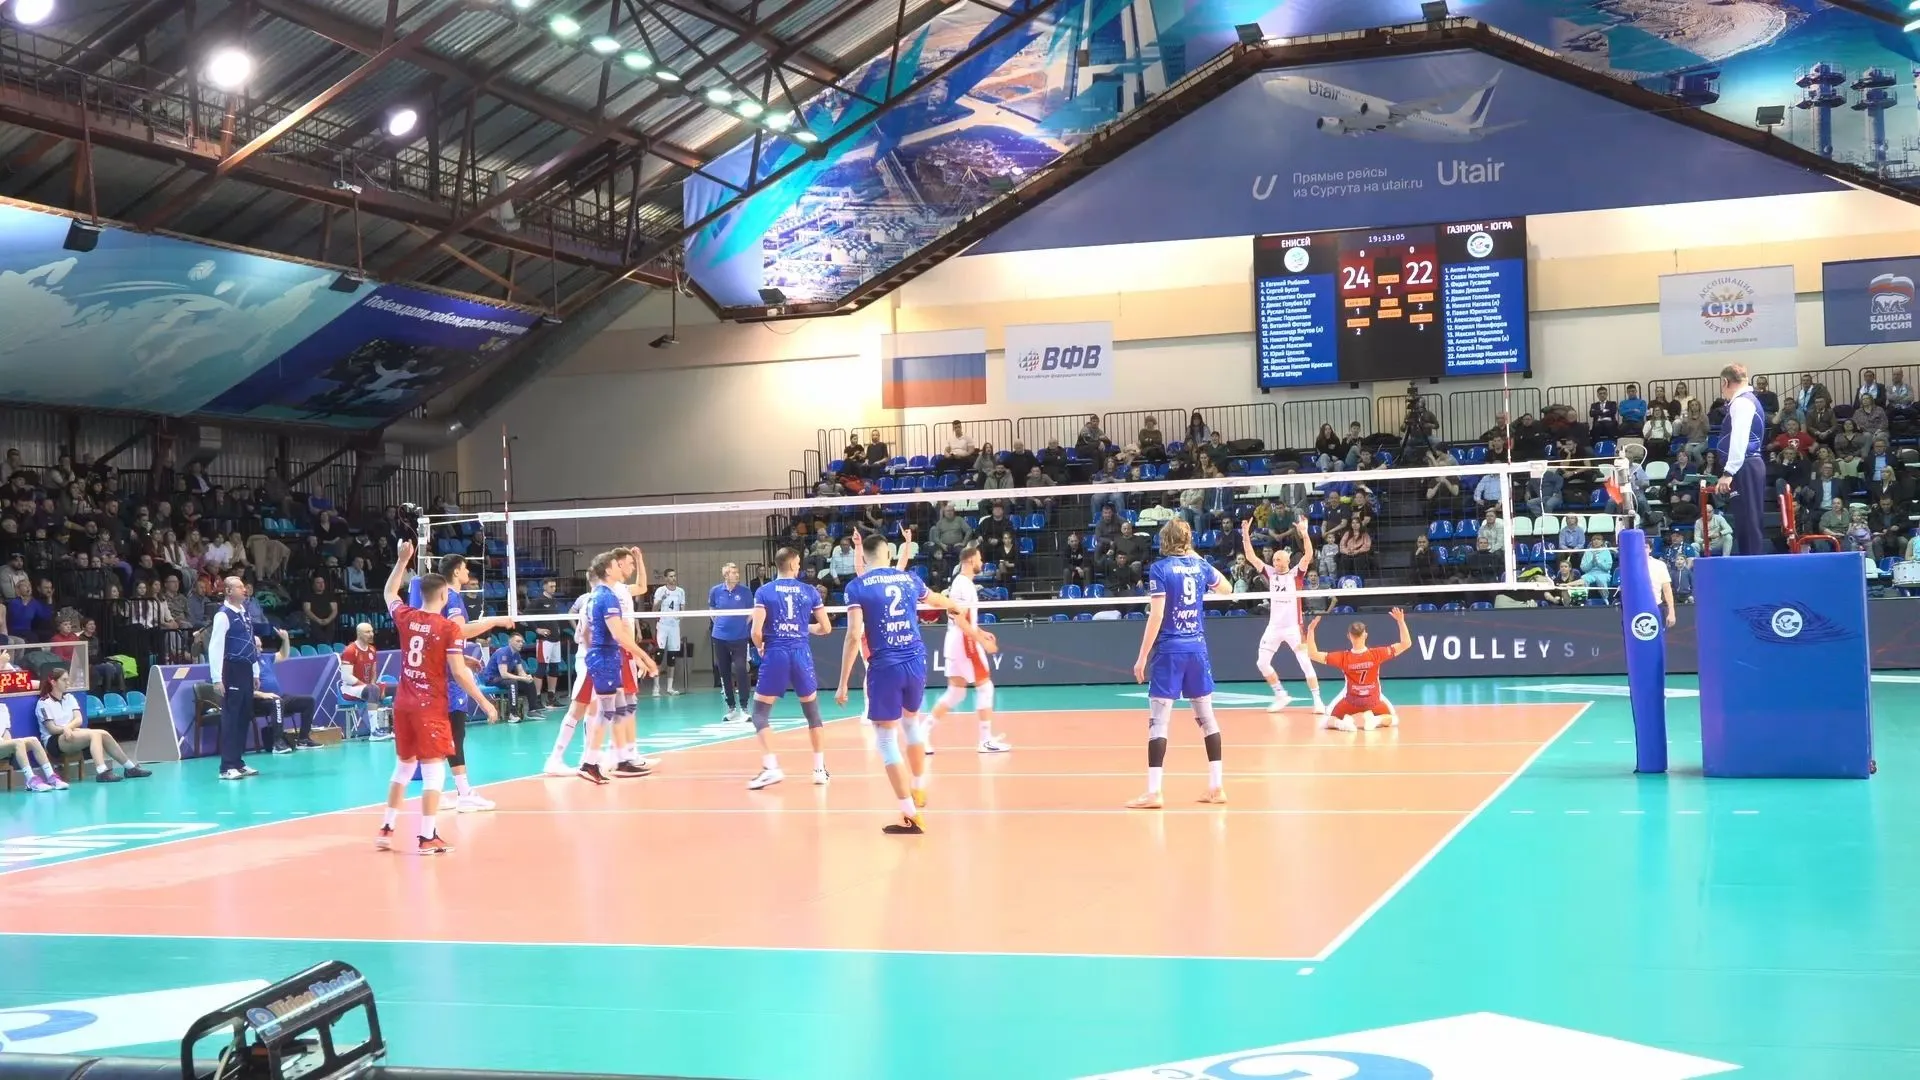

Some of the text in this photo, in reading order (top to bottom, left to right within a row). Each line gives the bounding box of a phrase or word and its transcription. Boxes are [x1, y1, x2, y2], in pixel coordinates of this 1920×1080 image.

[1308, 79, 1340, 101] Utair
[1293, 168, 1387, 184] Прямые рейсы
[1438, 157, 1505, 185] Utair
[1293, 179, 1423, 199] из Сургута на utair.ru
[1447, 224, 1483, 234] ГАЗПРОМ
[1491, 221, 1512, 230] ЮГРА
[1281, 236, 1310, 248] ЕНИСЕЙ
[1369, 234, 1405, 243] 19:33:05
[1343, 266, 1370, 289] 24
[1406, 261, 1433, 284] 22
[1386, 285, 1391, 294] 1
[1699, 276, 1755, 299] АССОЦИАЦИЯ
[1708, 302, 1747, 317] СВО
[1870, 313, 1911, 322] ЕДИНАЯ
[1704, 317, 1753, 334] ВЕТЕРАНОВ
[1871, 322, 1912, 331] РОССИЯ
[1041, 345, 1101, 370] ВФВ
[1183, 577, 1196, 605] 9
[669, 601, 674, 609] 4
[784, 595, 793, 619] 1
[885, 585, 905, 616] 2
[1177, 610, 1198, 619] ЮГРА
[779, 623, 798, 631] ЮГРА
[887, 620, 910, 632] ЮГРА
[408, 636, 424, 667] 8
[404, 668, 427, 679] ЮГРА
[1356, 670, 1367, 684] 7
